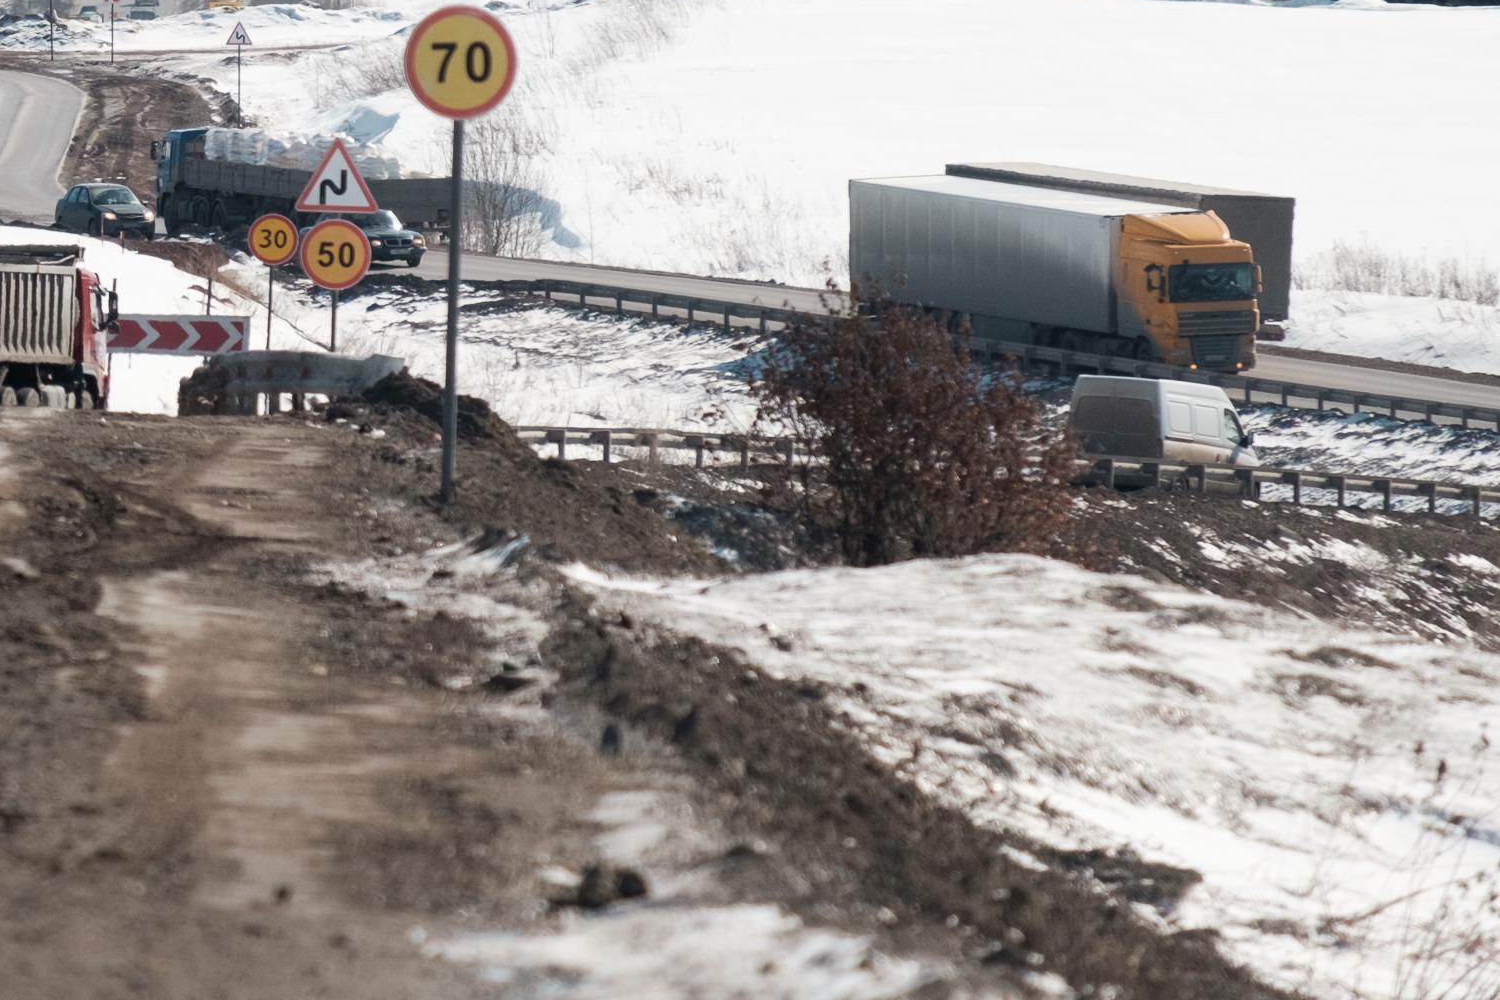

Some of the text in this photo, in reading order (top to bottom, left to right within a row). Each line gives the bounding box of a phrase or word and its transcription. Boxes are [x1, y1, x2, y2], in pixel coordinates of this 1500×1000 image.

[430, 41, 493, 83] 70
[259, 229, 288, 249] 30
[317, 241, 356, 268] 50
